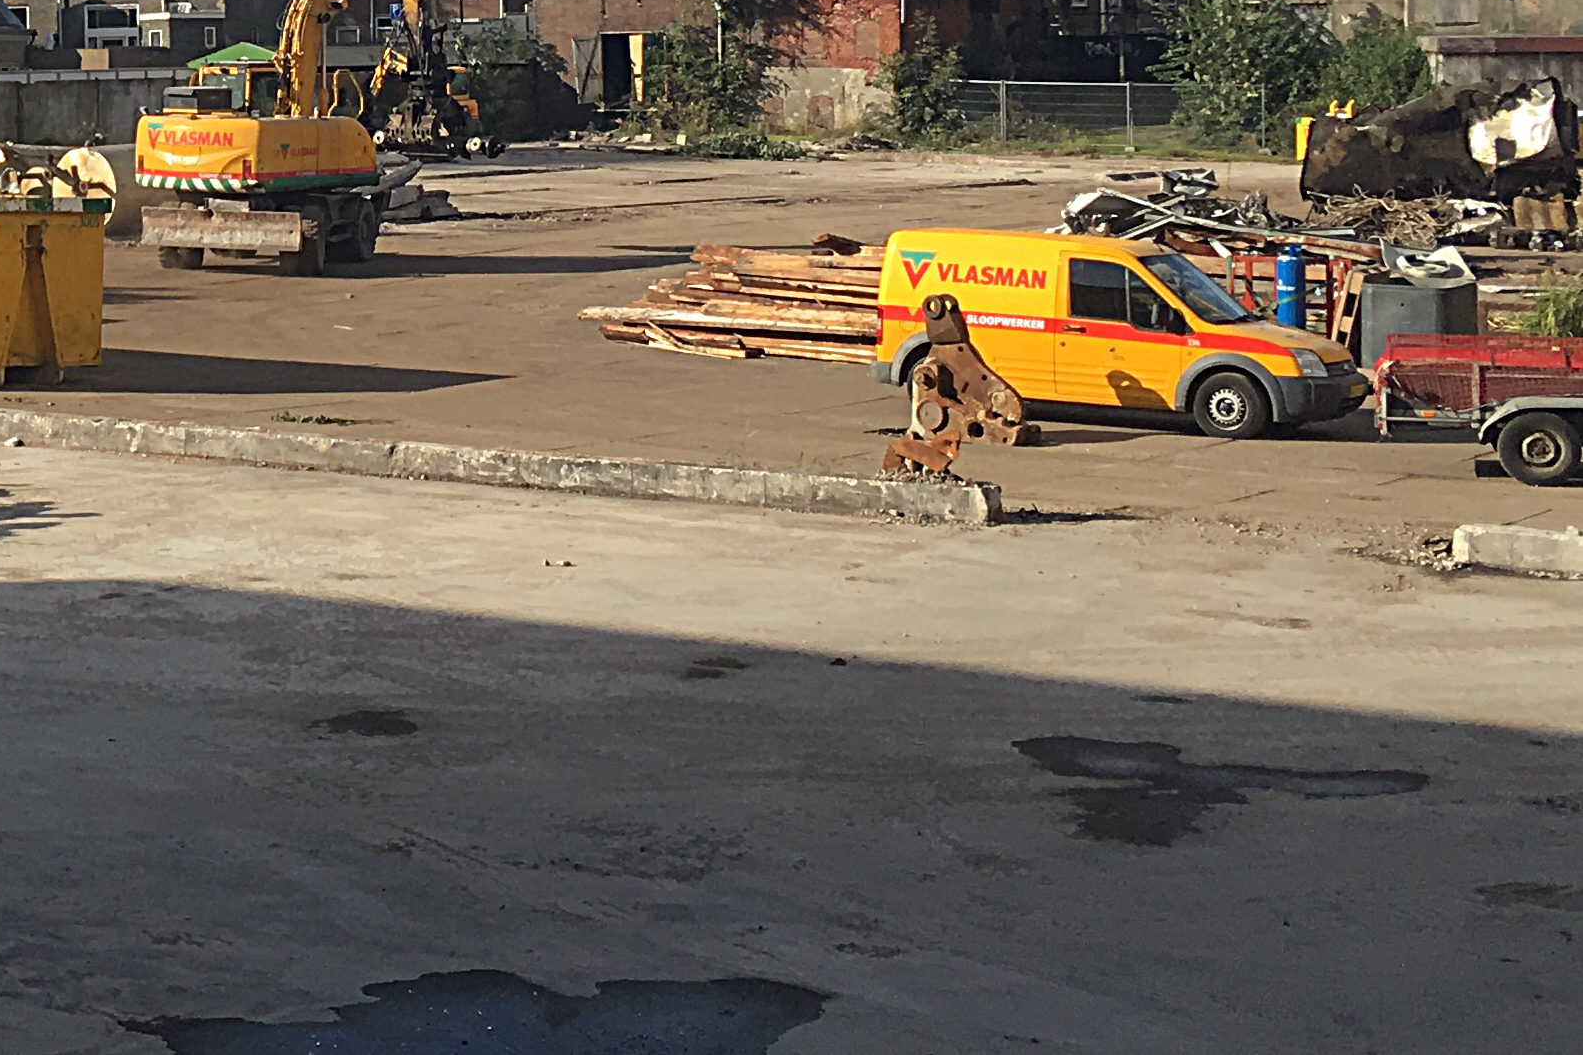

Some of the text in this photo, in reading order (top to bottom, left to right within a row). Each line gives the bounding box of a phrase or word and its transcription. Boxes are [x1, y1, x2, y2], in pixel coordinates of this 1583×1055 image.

[163, 129, 234, 147] VLASMAN
[937, 262, 1047, 289] VLASMAN
[966, 315, 1045, 330] SLOOPWERKEN
